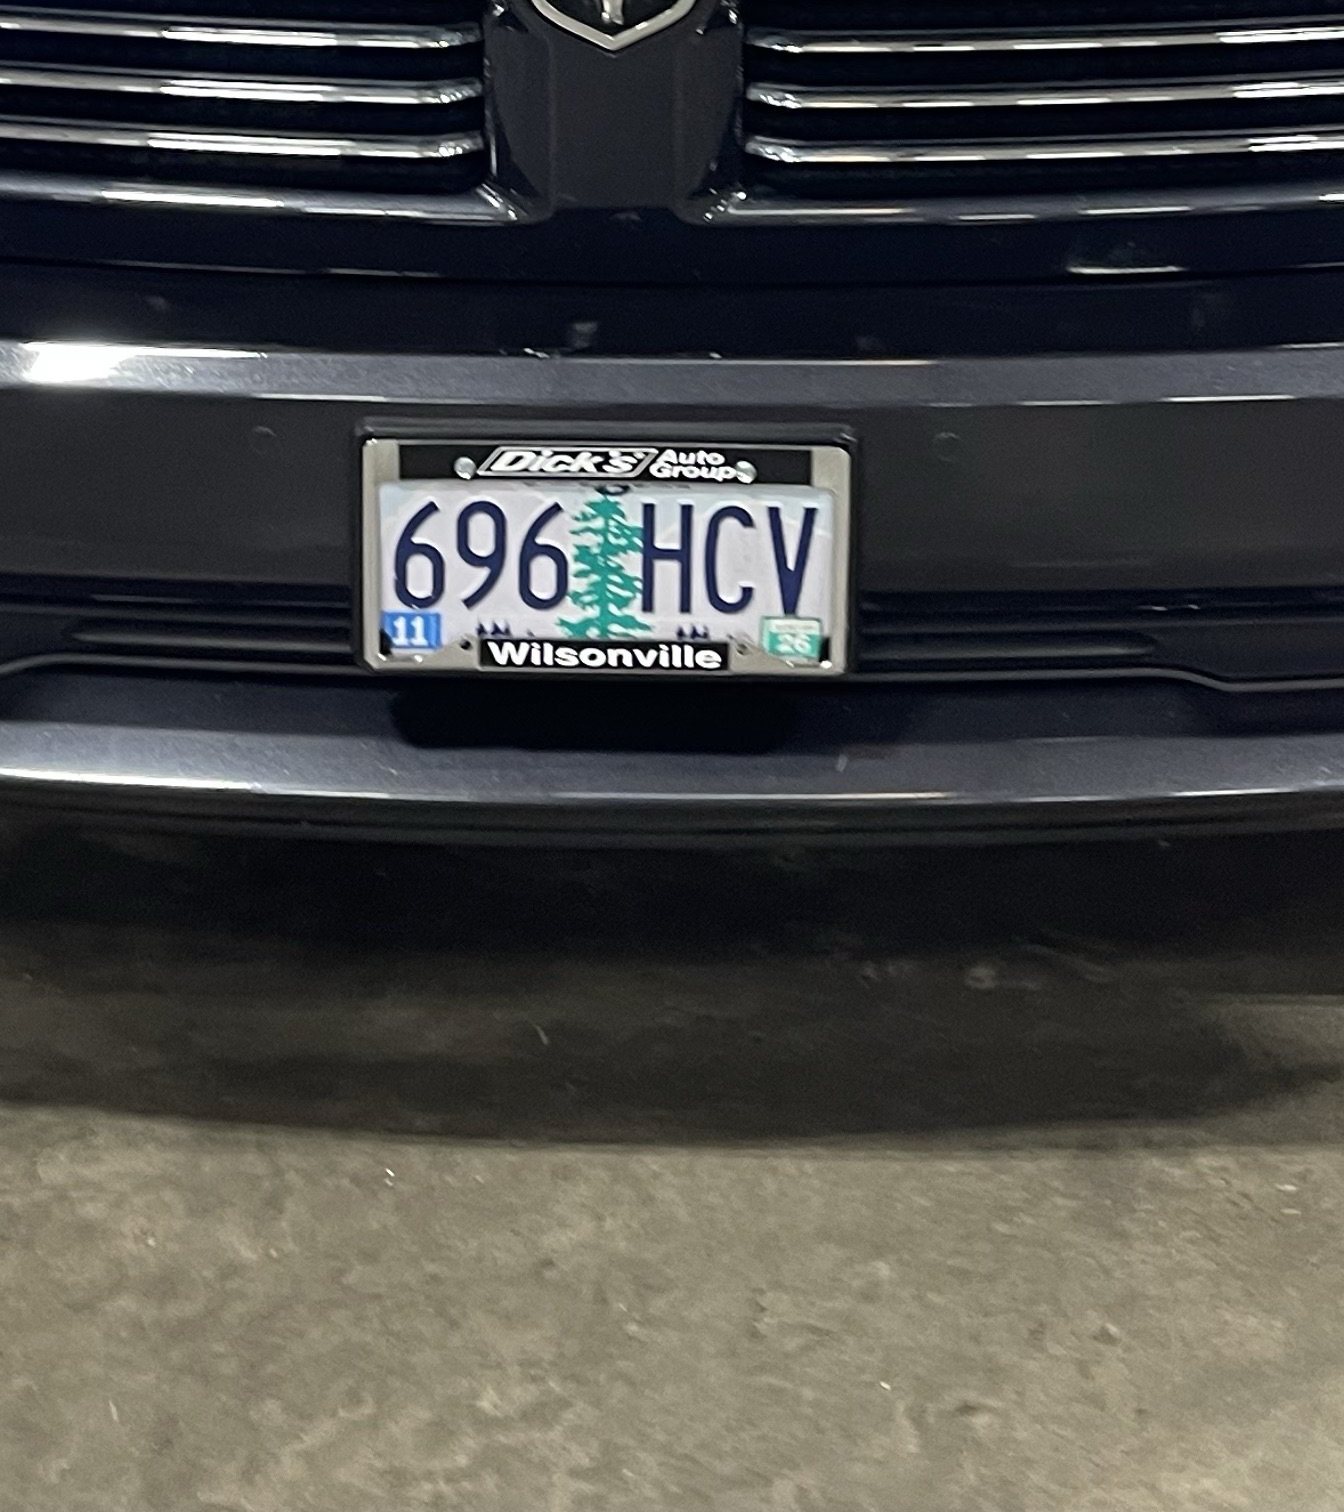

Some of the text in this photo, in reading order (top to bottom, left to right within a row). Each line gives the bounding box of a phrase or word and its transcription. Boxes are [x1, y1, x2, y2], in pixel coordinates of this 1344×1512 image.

[490, 449, 640, 474] Dick's
[658, 449, 726, 465] Auto
[393, 500, 819, 616] 696 HCV
[392, 616, 426, 647] 11
[487, 640, 723, 669] Wilsonville
